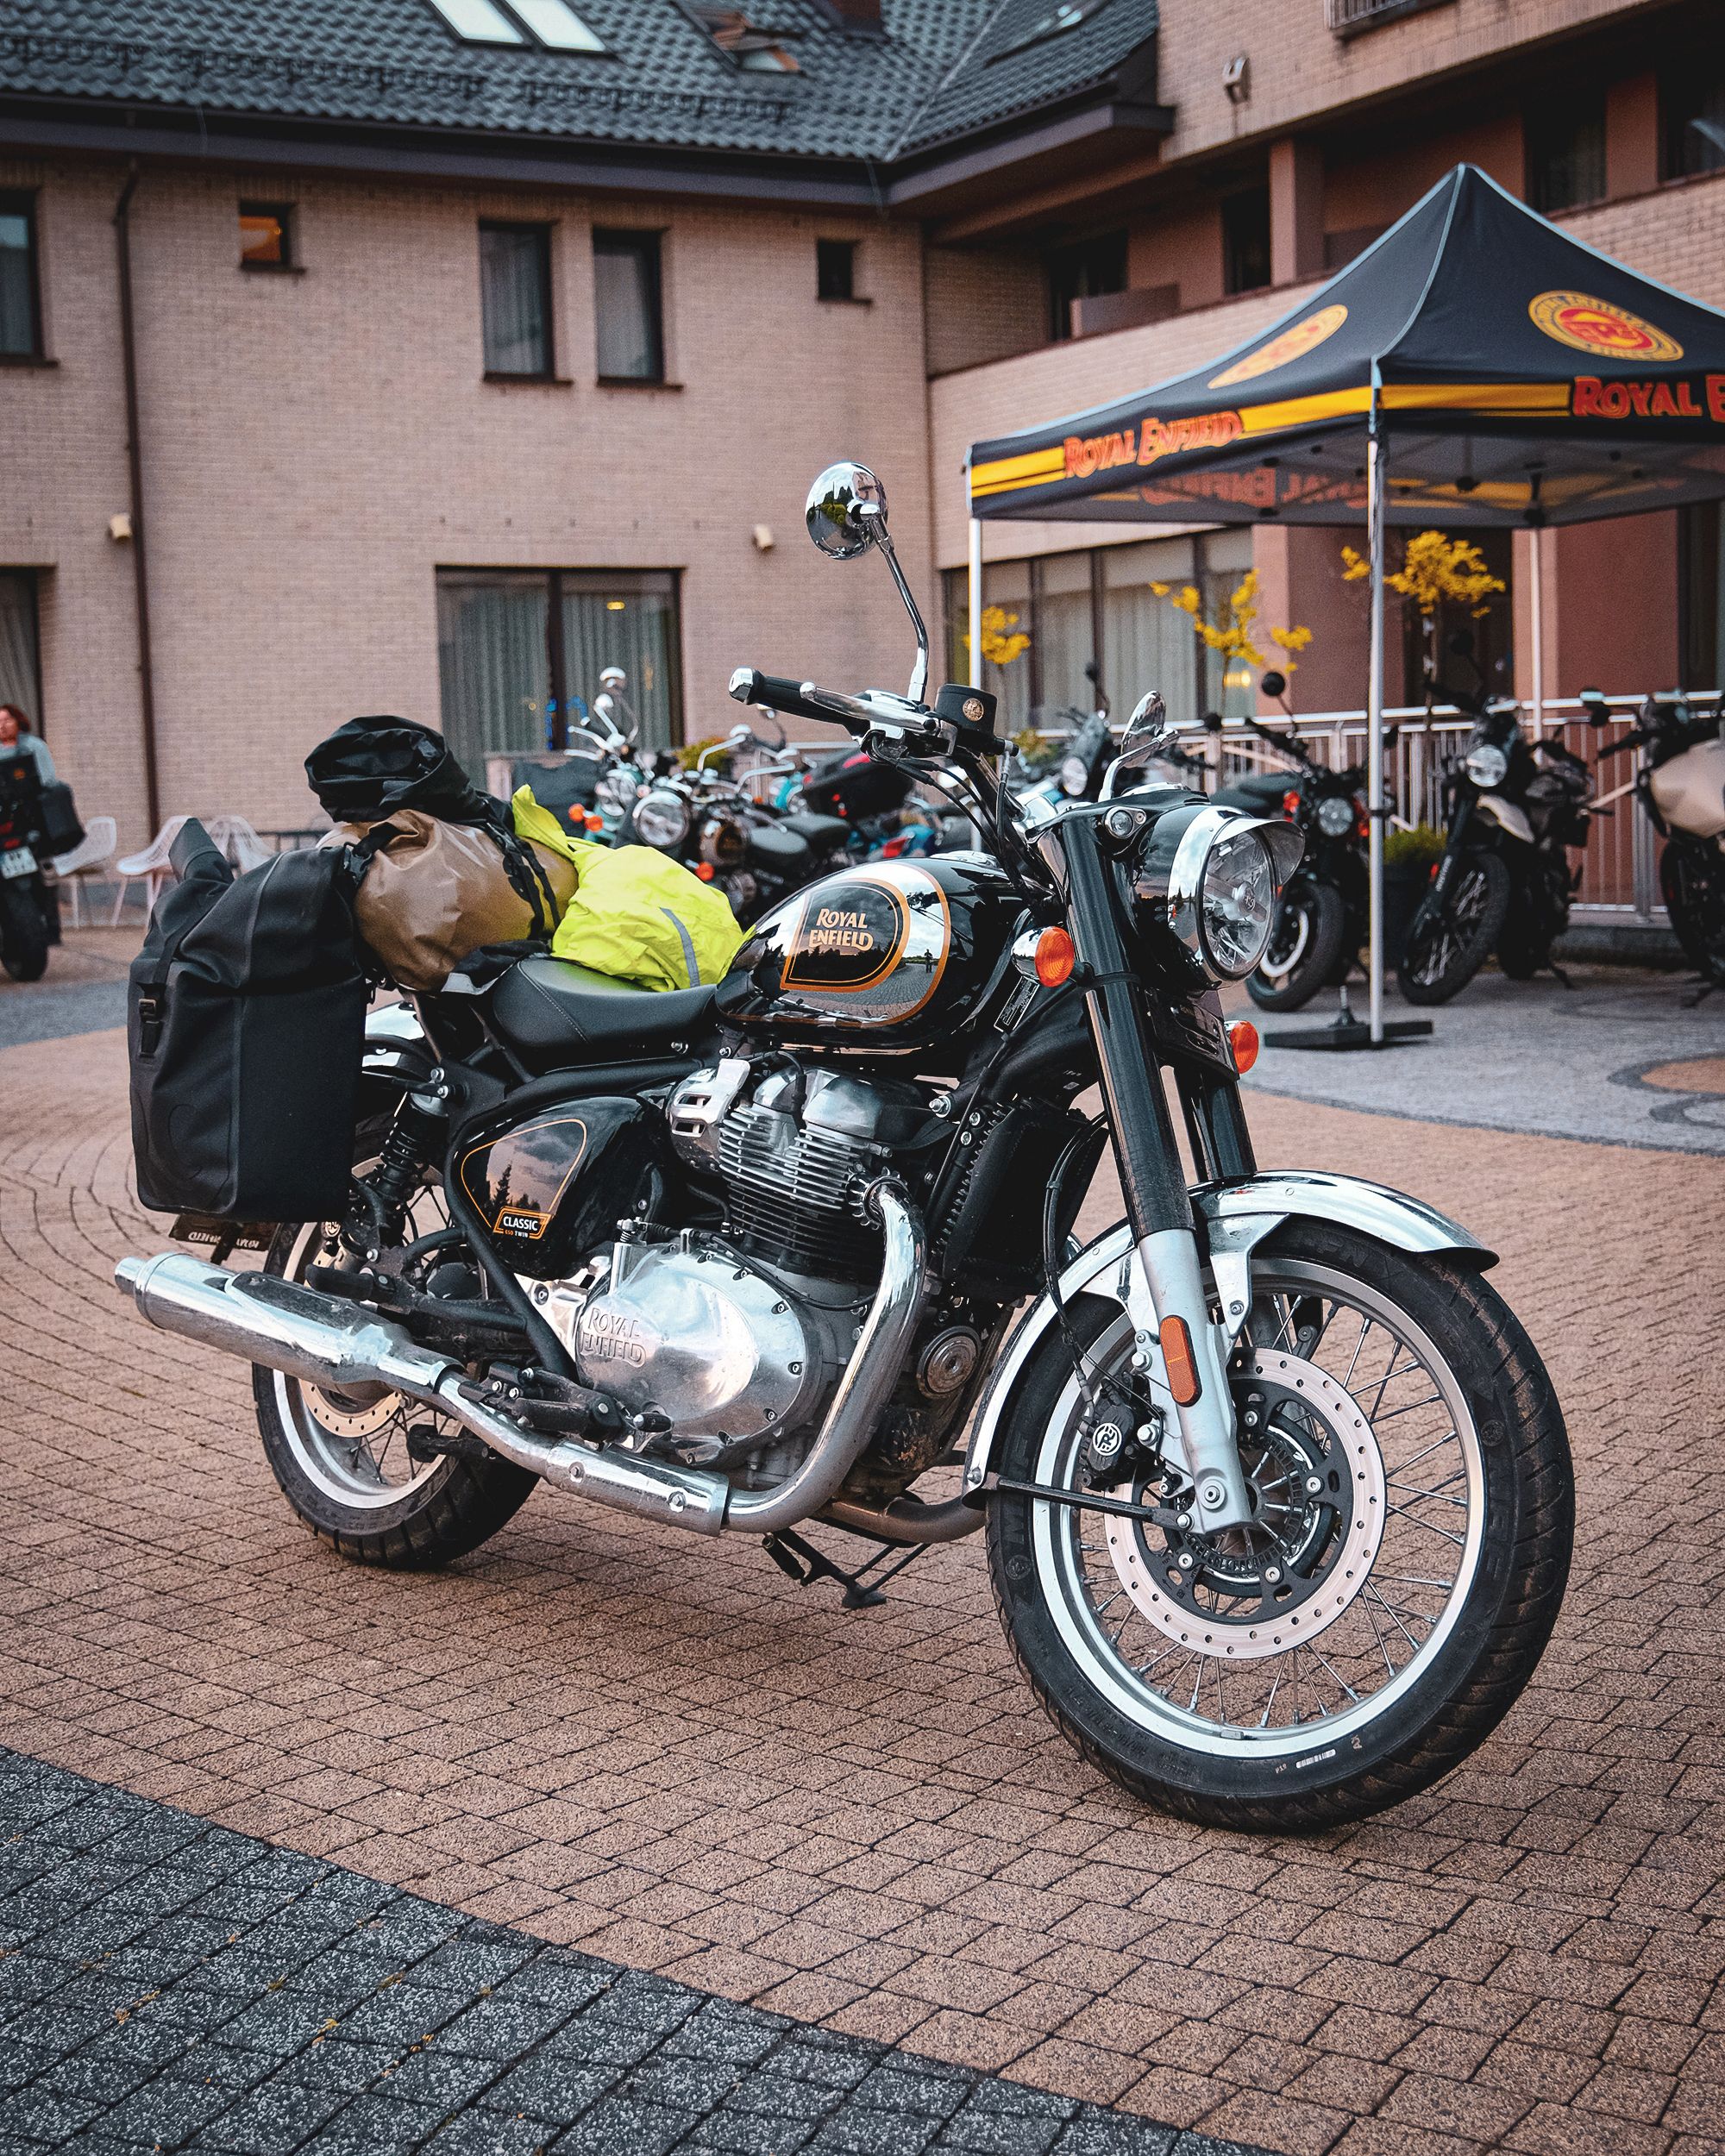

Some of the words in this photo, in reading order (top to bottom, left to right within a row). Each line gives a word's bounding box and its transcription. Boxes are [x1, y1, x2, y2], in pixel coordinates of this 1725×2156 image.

[1573, 375, 1703, 419] ROYAL
[1064, 436, 1137, 478] ROYAL
[1137, 417, 1243, 466] ENFIELD
[816, 908, 868, 929] ROYAL
[809, 929, 874, 951] ENFIELD
[503, 1216, 538, 1231] CLASSIC
[588, 1307, 640, 1338] ROYAL
[580, 1332, 647, 1368] ENFIELD
